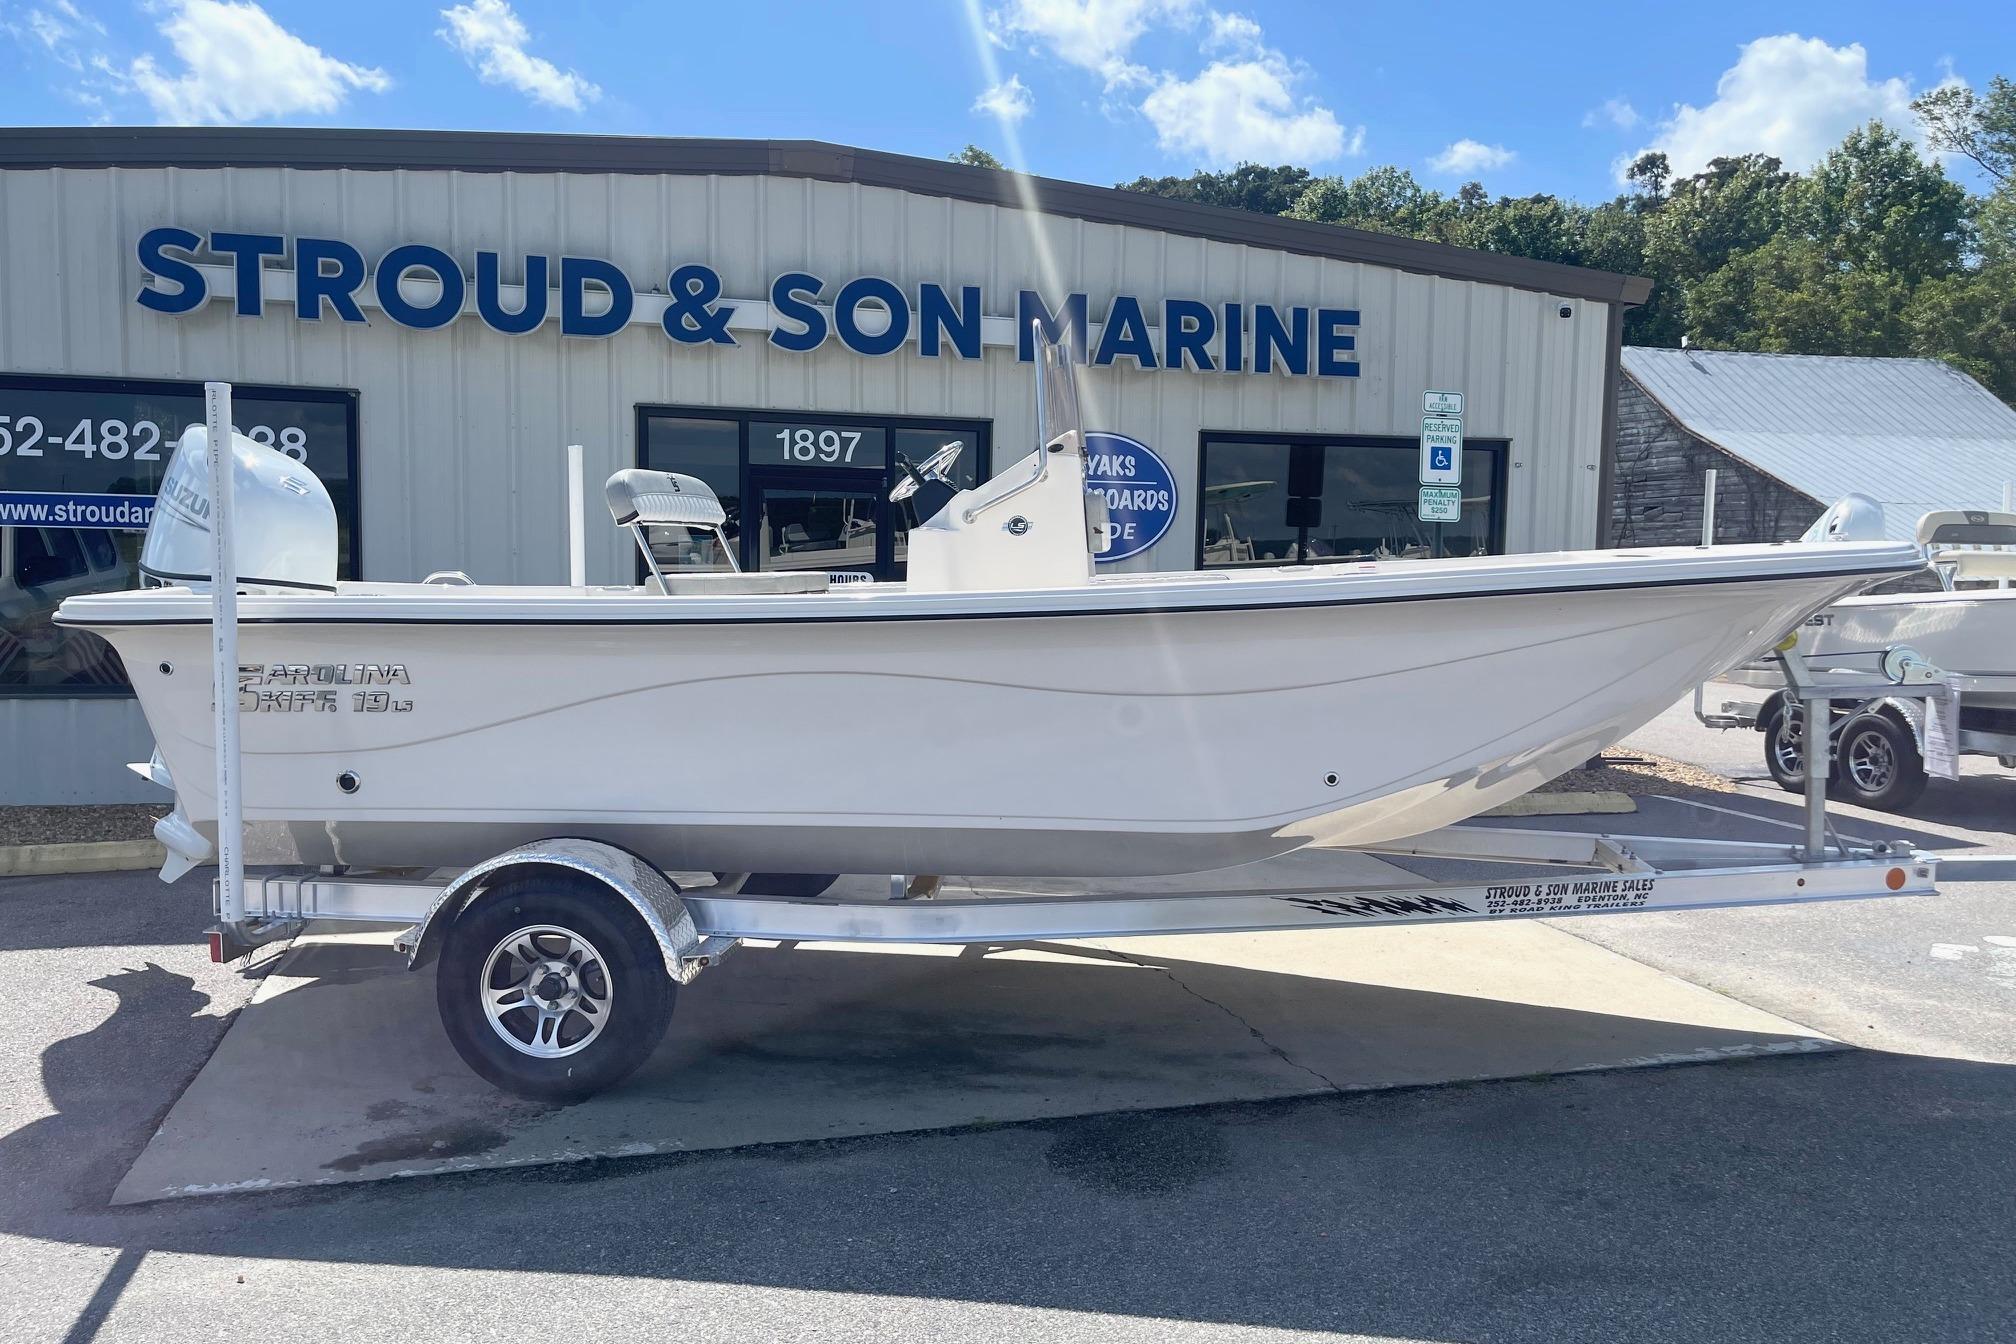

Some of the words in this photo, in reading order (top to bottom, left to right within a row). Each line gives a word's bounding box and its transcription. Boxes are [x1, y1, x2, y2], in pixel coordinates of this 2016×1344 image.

[136, 225, 636, 338] STROUD
[661, 262, 739, 346] &
[767, 271, 983, 361] SON
[1014, 288, 1362, 380] MARINE
[1424, 422, 1460, 433] RESERVED
[776, 428, 862, 463] 1897
[1426, 434, 1457, 445] PARKING
[1087, 487, 1169, 511] OARDS
[1422, 490, 1458, 499] MAXIMUM
[1423, 498, 1457, 507] PENALTY
[829, 574, 867, 584] HOURS
[223, 846, 231, 906] CHARLOTTE
[1485, 886, 1531, 899] STROUD
[1534, 884, 1543, 897] &
[1545, 883, 1569, 896] SON
[1572, 880, 1618, 895] MARINE
[1621, 879, 1655, 892] SALES
[1487, 896, 1563, 908] 252-482-8938
[1577, 893, 1630, 903] EDENTON,
[1634, 892, 1649, 900] NC
[1509, 906, 1545, 914] ROAD
[1548, 903, 1581, 911] KING
[1586, 900, 1646, 910] TRAILERS
